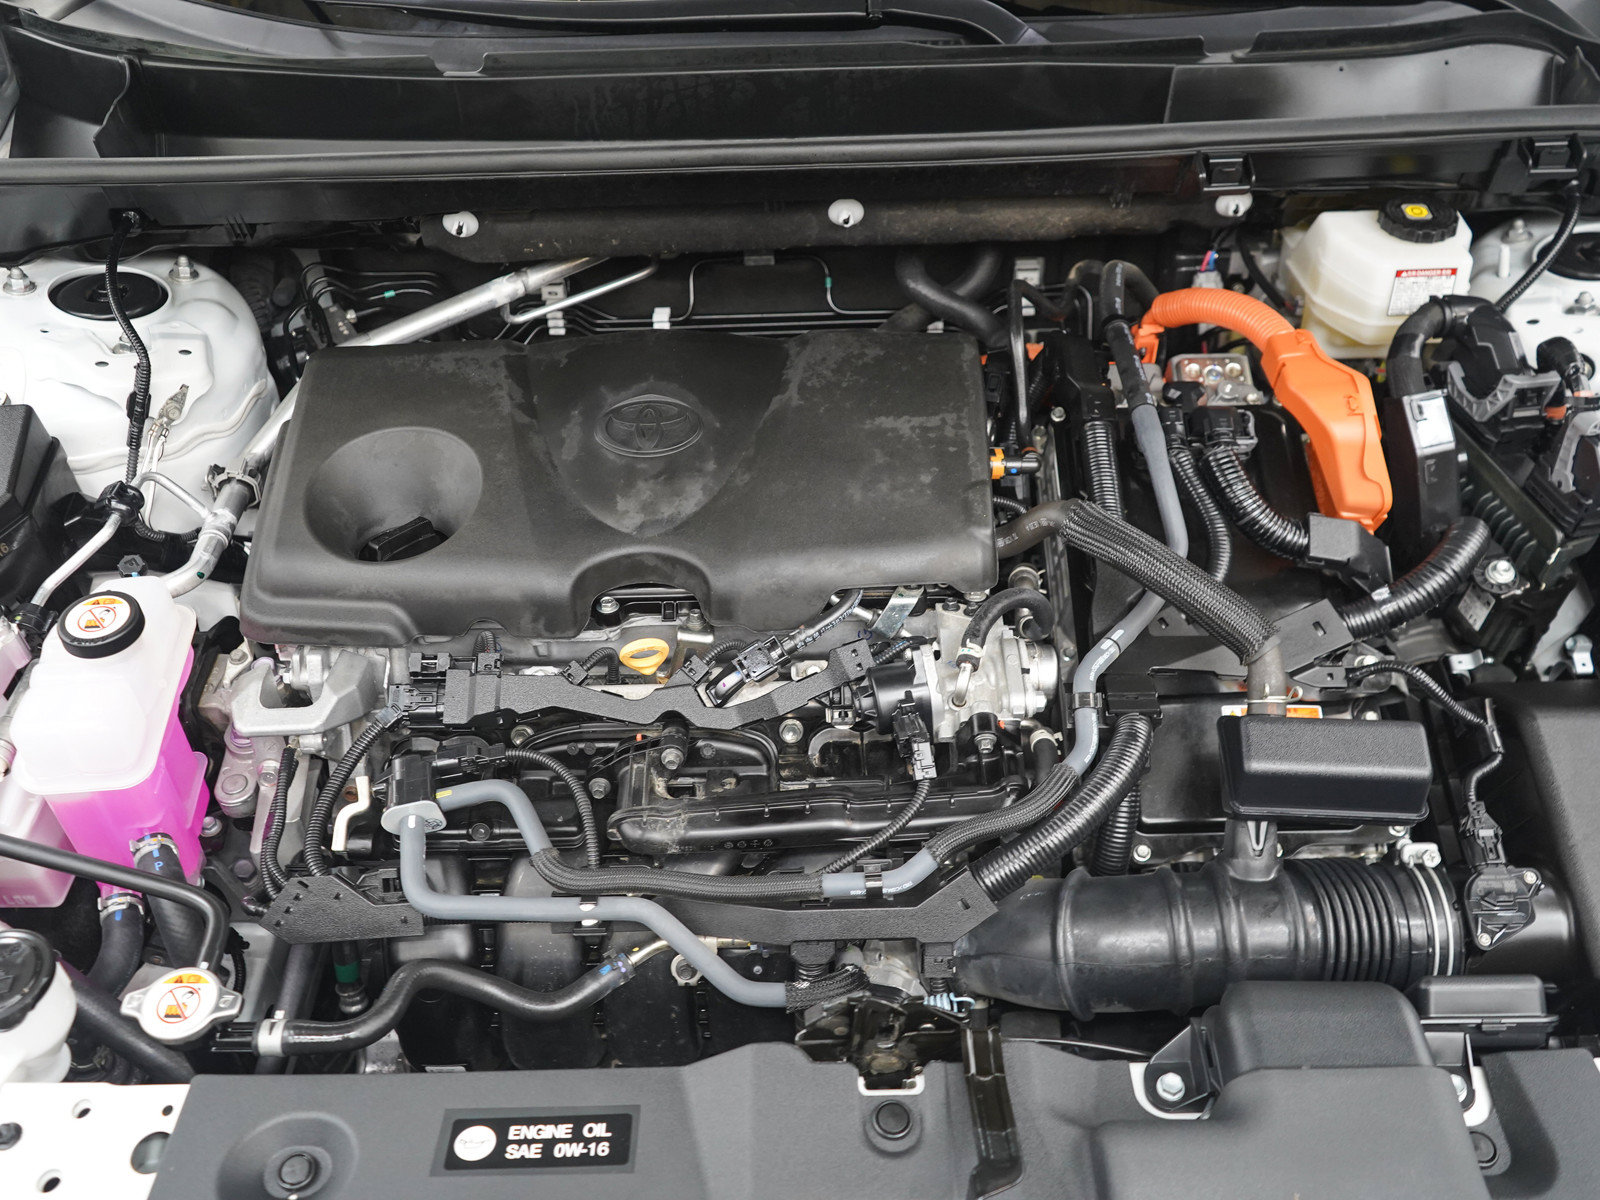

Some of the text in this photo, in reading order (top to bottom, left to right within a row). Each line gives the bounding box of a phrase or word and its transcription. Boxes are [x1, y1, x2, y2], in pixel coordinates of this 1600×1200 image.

[2, 895, 38, 905] LOW
[507, 1122, 612, 1140] ENGINE OIL
[504, 1141, 610, 1160] SAE 0W-16
